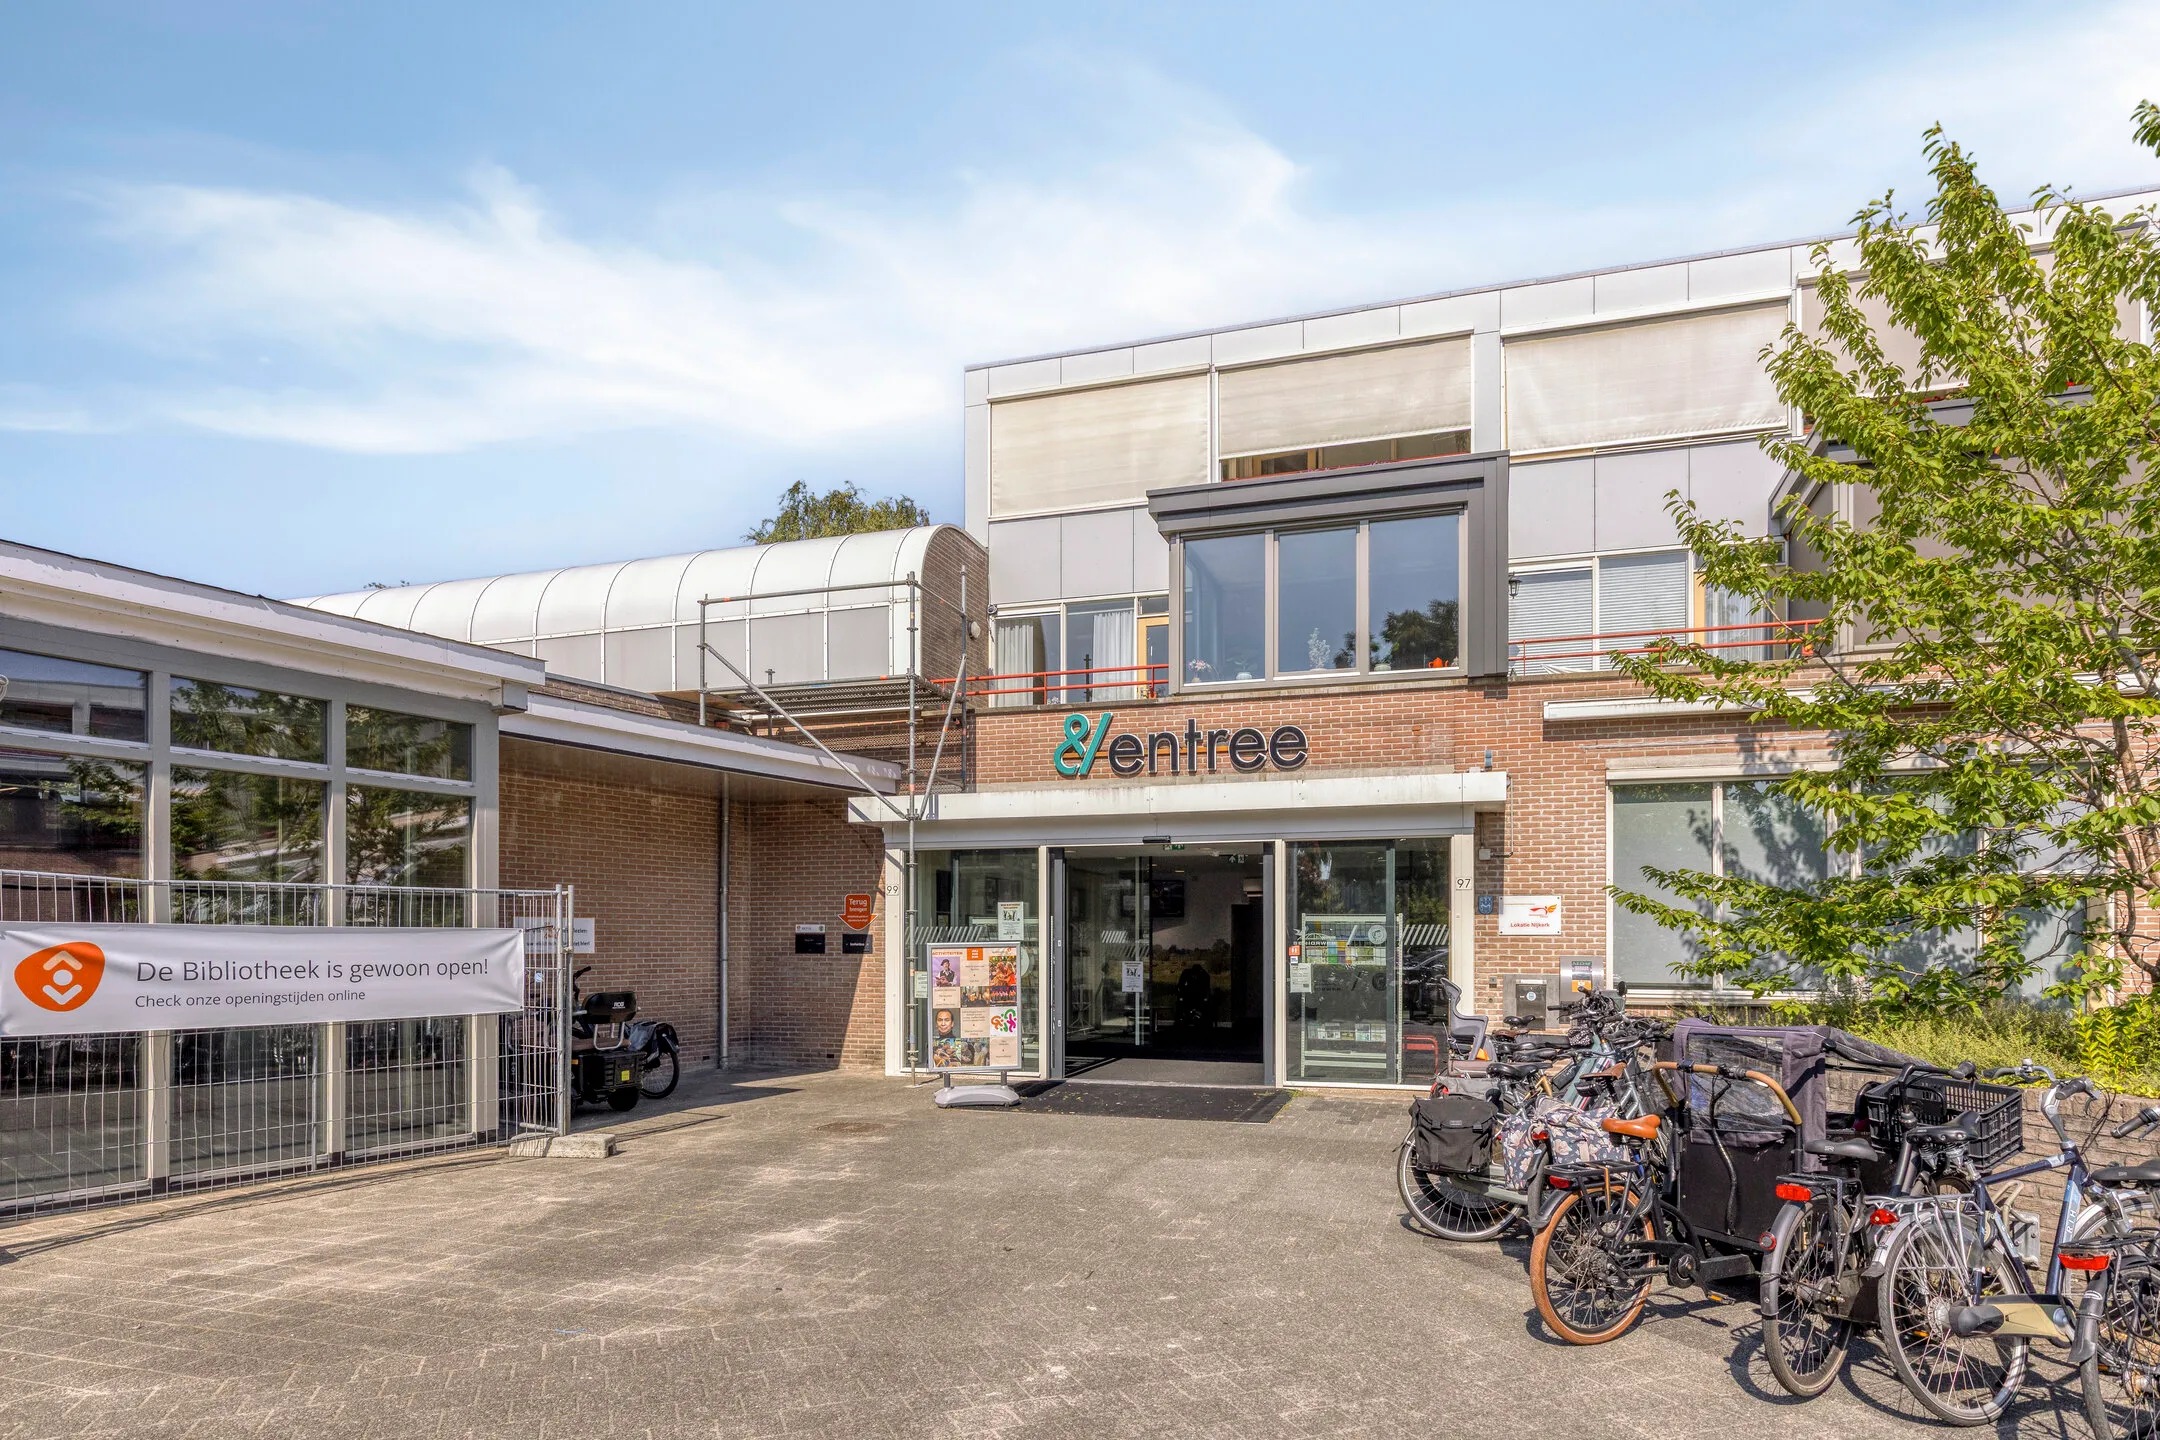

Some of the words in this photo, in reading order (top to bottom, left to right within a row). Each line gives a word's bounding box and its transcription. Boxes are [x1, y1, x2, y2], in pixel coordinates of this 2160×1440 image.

[886, 885, 899, 893] 99
[1456, 878, 1471, 889] 97
[849, 898, 868, 907] Terug
[136, 962, 173, 982] De
[183, 960, 320, 981] Bibliotheek
[327, 960, 343, 979] is
[349, 963, 430, 983] gewoon
[436, 958, 489, 980] open!
[135, 994, 181, 1008] Check
[185, 995, 221, 1007] onze
[225, 991, 324, 1007] openingstijden
[328, 990, 366, 1002] online
